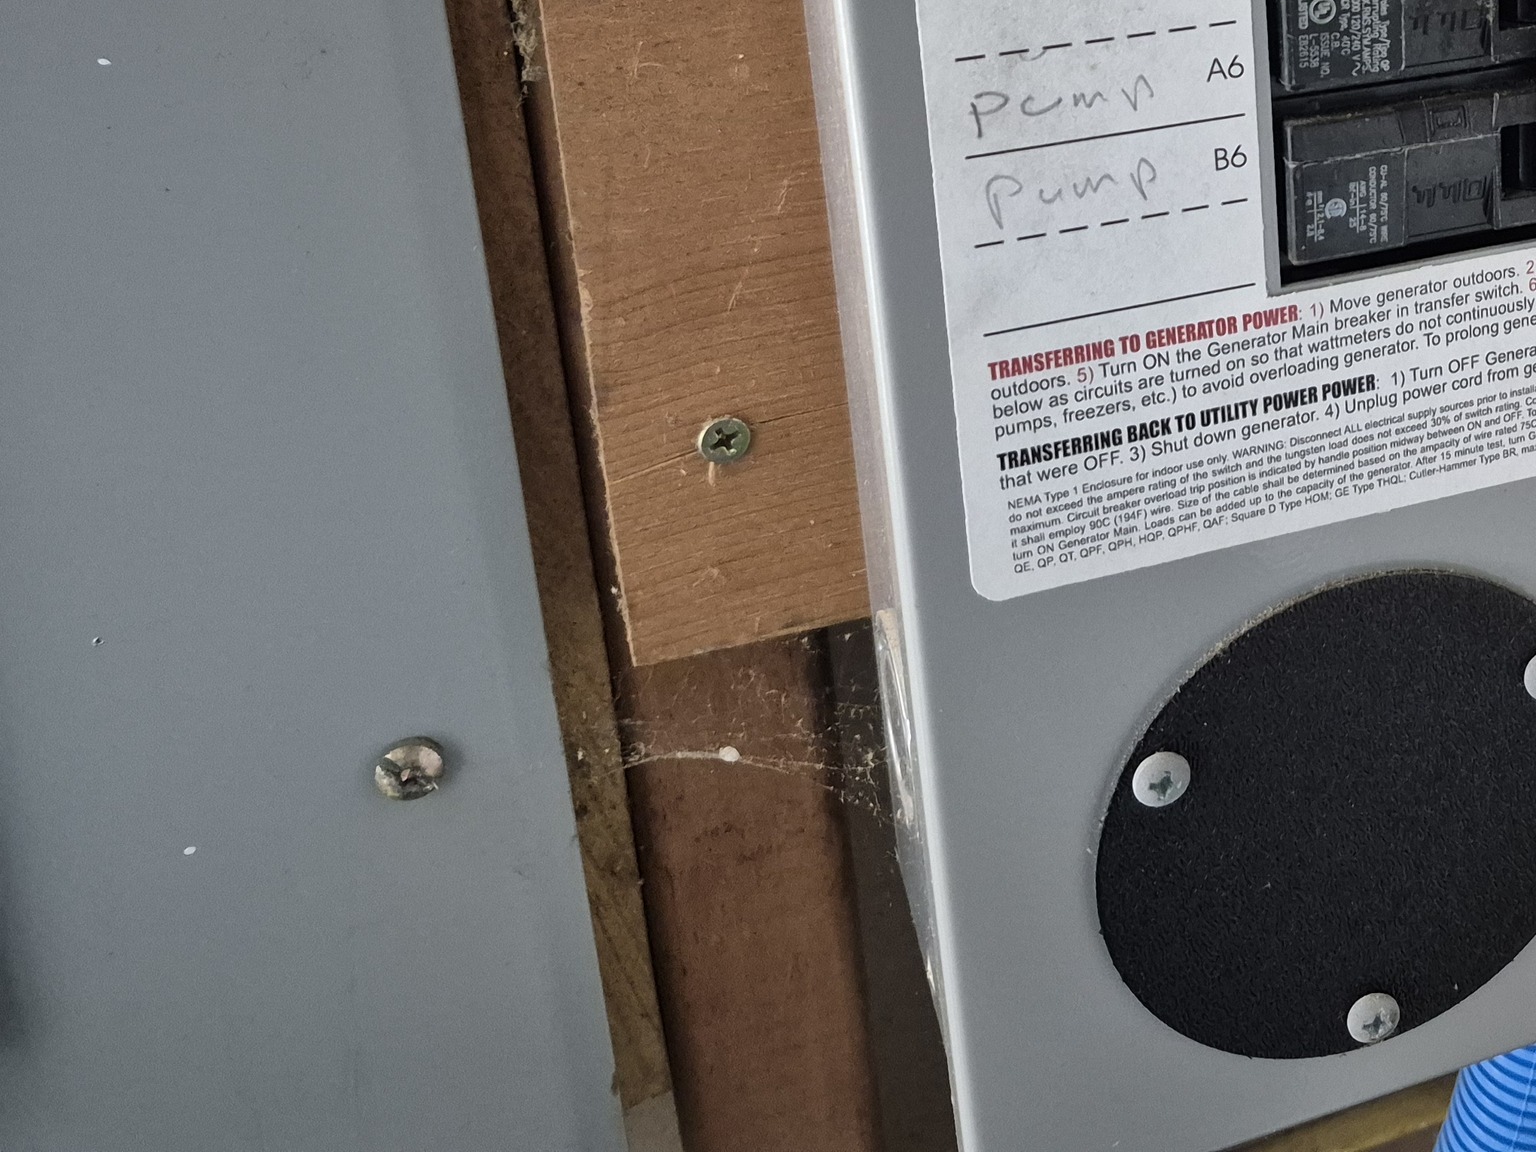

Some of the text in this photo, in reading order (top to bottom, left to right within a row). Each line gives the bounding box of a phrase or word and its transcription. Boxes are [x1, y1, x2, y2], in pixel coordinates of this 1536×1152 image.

[1207, 54, 1245, 83] A6
[1214, 144, 1248, 171] B6
[988, 339, 1115, 380] TRANSFERRING
[1119, 334, 1140, 354] TO
[1146, 316, 1237, 349] GENERATOR
[1243, 305, 1302, 331] POWER:
[1310, 303, 1324, 317] 1)
[1330, 296, 1370, 313] Move
[1377, 280, 1447, 307] generator
[1453, 267, 1519, 288] outdoors.
[997, 374, 1379, 471] TRANSFERRING BACK TO UTILITY POWER POWER:
